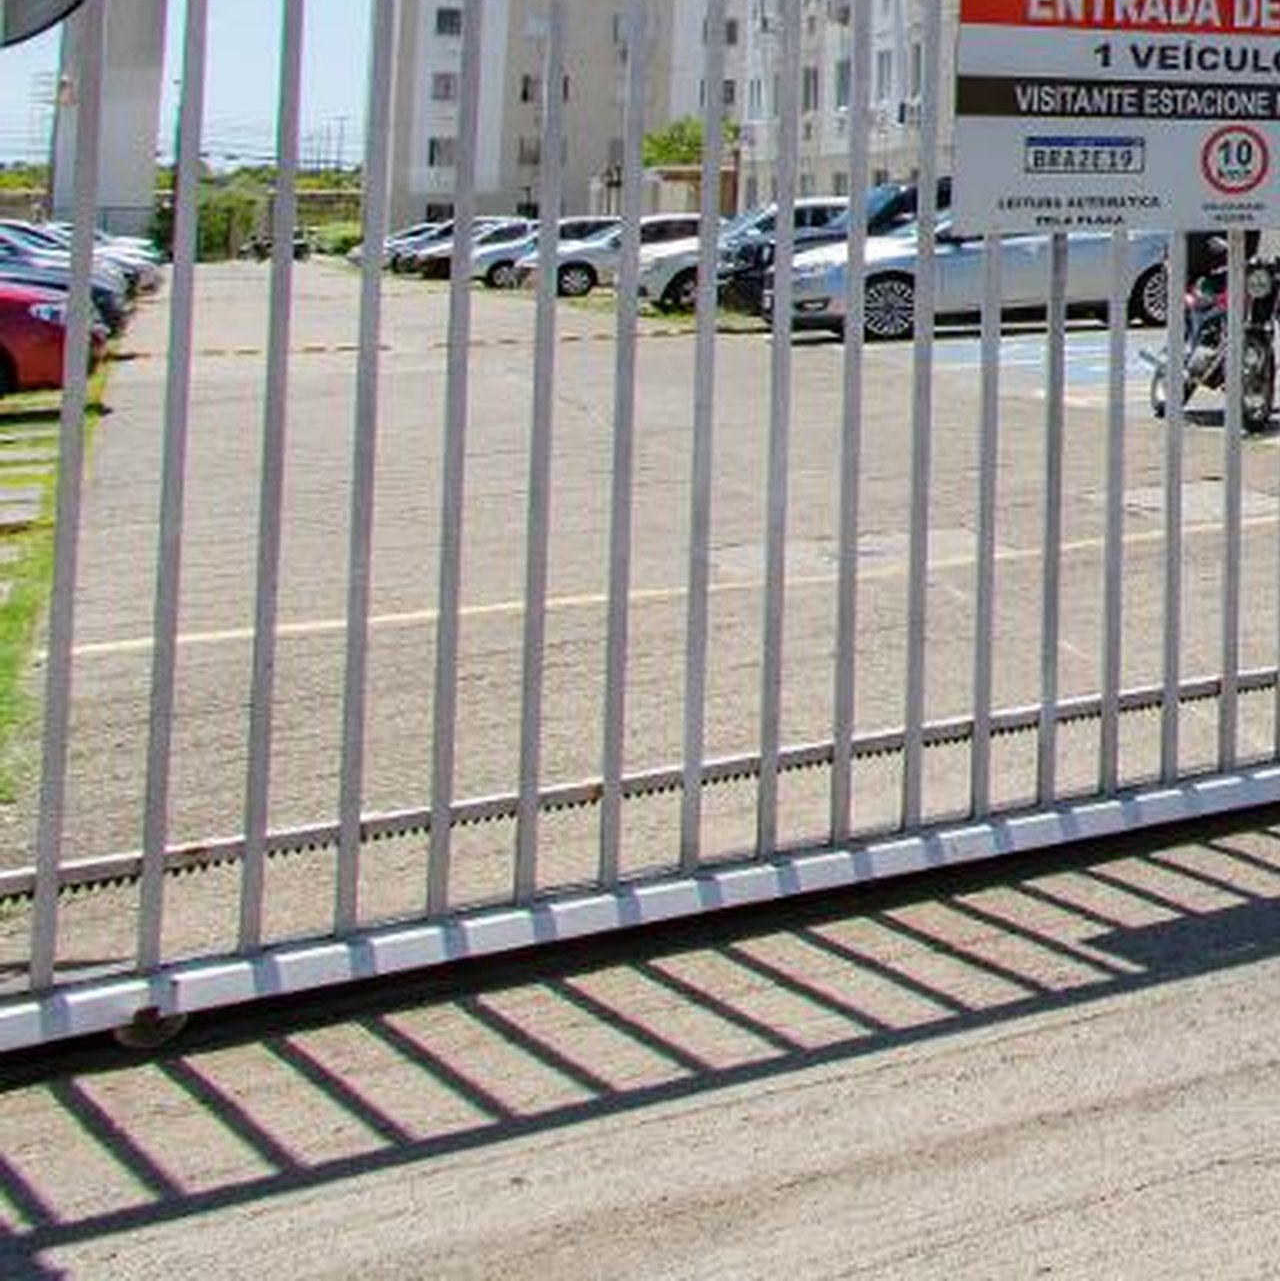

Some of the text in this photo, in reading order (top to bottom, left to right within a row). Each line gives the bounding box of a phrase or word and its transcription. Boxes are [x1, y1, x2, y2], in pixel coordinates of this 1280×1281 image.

[1093, 43, 1112, 68] 1
[1014, 84, 1141, 114] VISITANTE
[1143, 88, 1270, 117] ESTACIONE
[1217, 139, 1253, 167] 10
